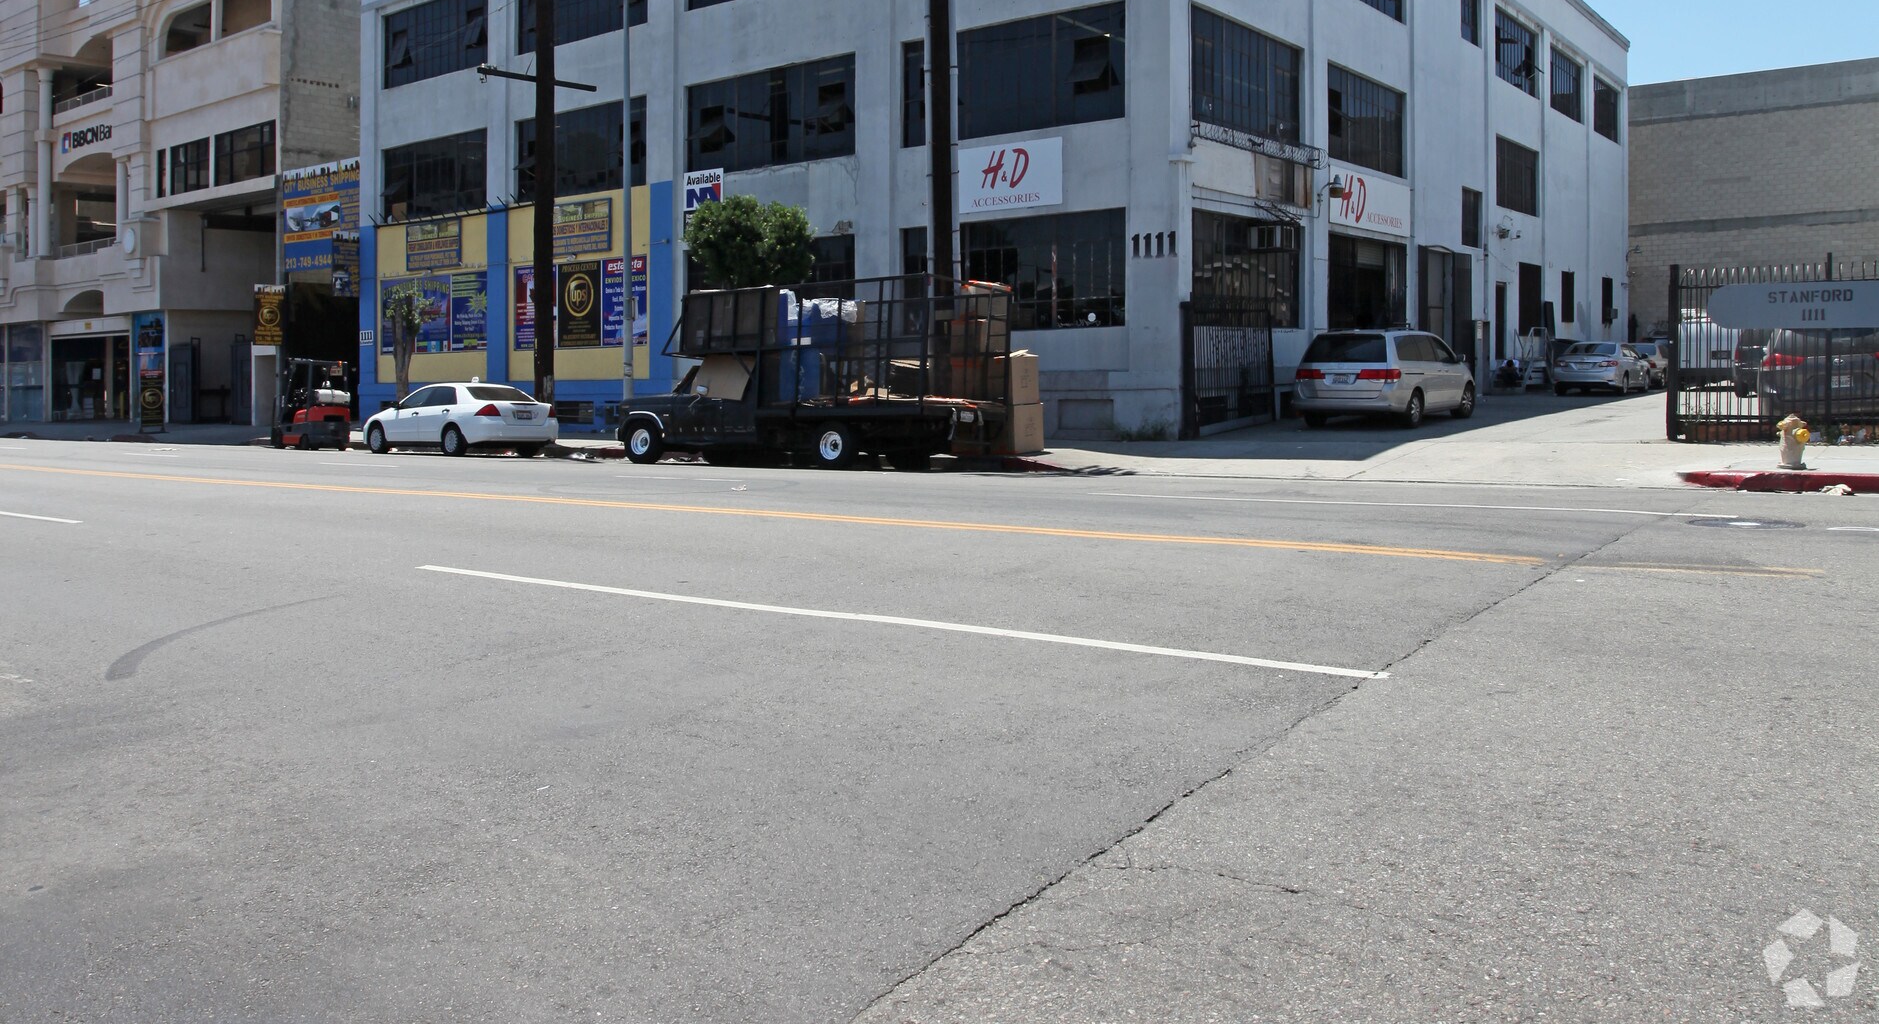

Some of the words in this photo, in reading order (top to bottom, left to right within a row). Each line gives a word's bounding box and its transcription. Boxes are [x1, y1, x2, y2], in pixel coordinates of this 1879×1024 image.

[72, 126, 99, 149] BBCN
[981, 147, 1030, 190] H&D
[284, 180, 296, 194] CITY
[297, 174, 329, 192] BUSINESS
[330, 169, 360, 185] SHIPPING
[686, 171, 721, 187] Available
[971, 192, 1041, 208] ACCESSORIES
[1366, 212, 1403, 229] ACCESSORIES
[1131, 231, 1178, 259] 1111
[561, 264, 579, 273] PROCESS
[581, 262, 598, 271] CENTER
[607, 259, 643, 271] estata
[424, 279, 450, 295] SHIPPING
[605, 277, 622, 285] ENVIOS
[571, 288, 587, 307] ups
[1767, 288, 1854, 304] STANFORD
[1801, 308, 1826, 321] 1111
[361, 331, 372, 340] 1111
